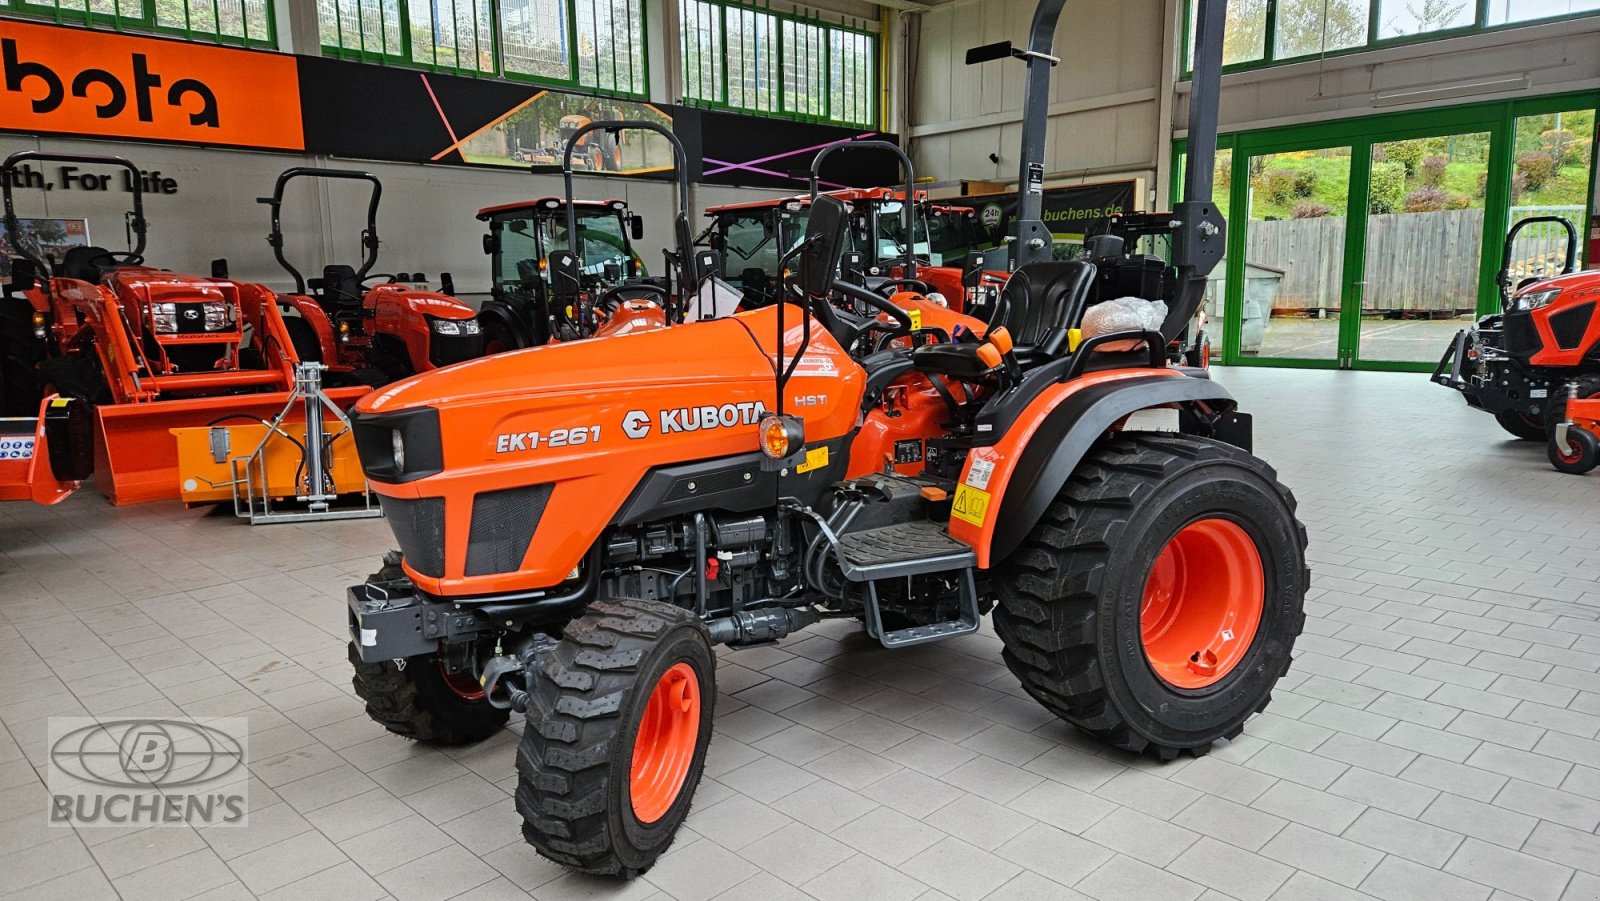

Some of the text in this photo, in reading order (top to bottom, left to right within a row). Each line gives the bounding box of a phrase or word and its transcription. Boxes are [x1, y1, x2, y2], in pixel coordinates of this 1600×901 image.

[1, 37, 220, 129] bota
[0, 164, 178, 194] th, For Life
[985, 209, 999, 217] 24h
[1009, 204, 1123, 222] buchens.de
[794, 394, 828, 406] HST
[660, 401, 766, 434] KUBOTA
[496, 425, 601, 453] EK1-261
